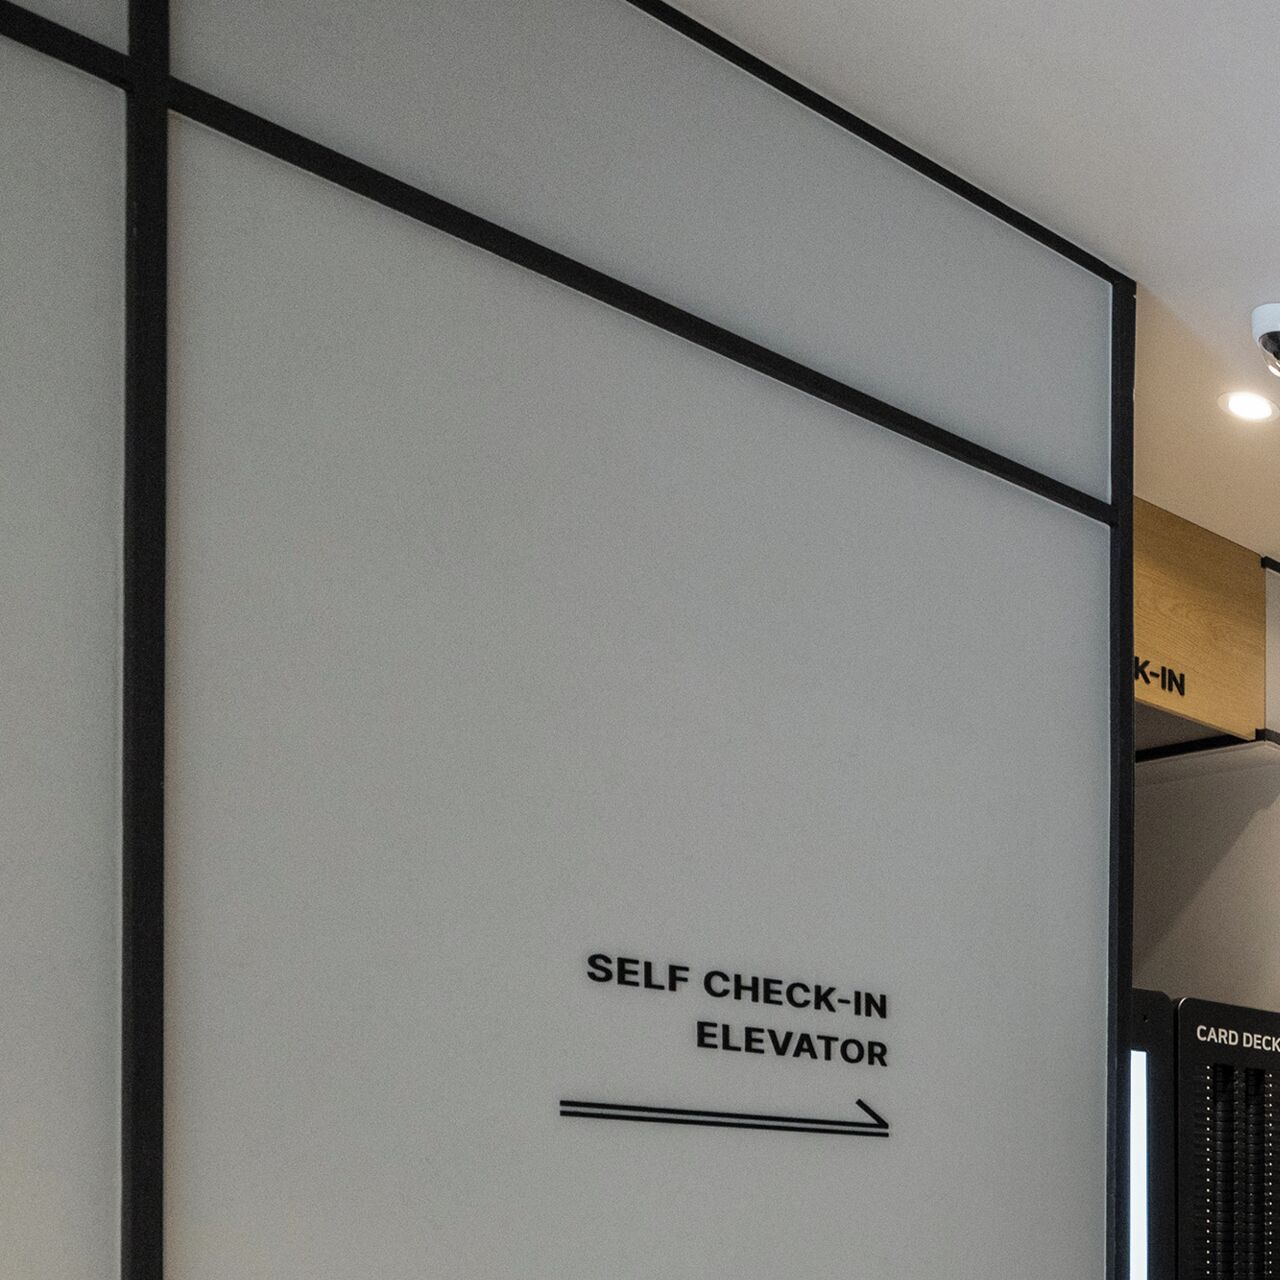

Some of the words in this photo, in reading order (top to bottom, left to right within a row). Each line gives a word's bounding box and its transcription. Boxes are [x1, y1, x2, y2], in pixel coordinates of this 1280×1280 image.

[587, 953, 689, 992] SELF
[703, 970, 887, 1019] CHECK-IN
[696, 1021, 888, 1067] ELEVATOR
[1196, 1024, 1239, 1046] CARD
[1242, 1031, 1280, 1053] DECK
